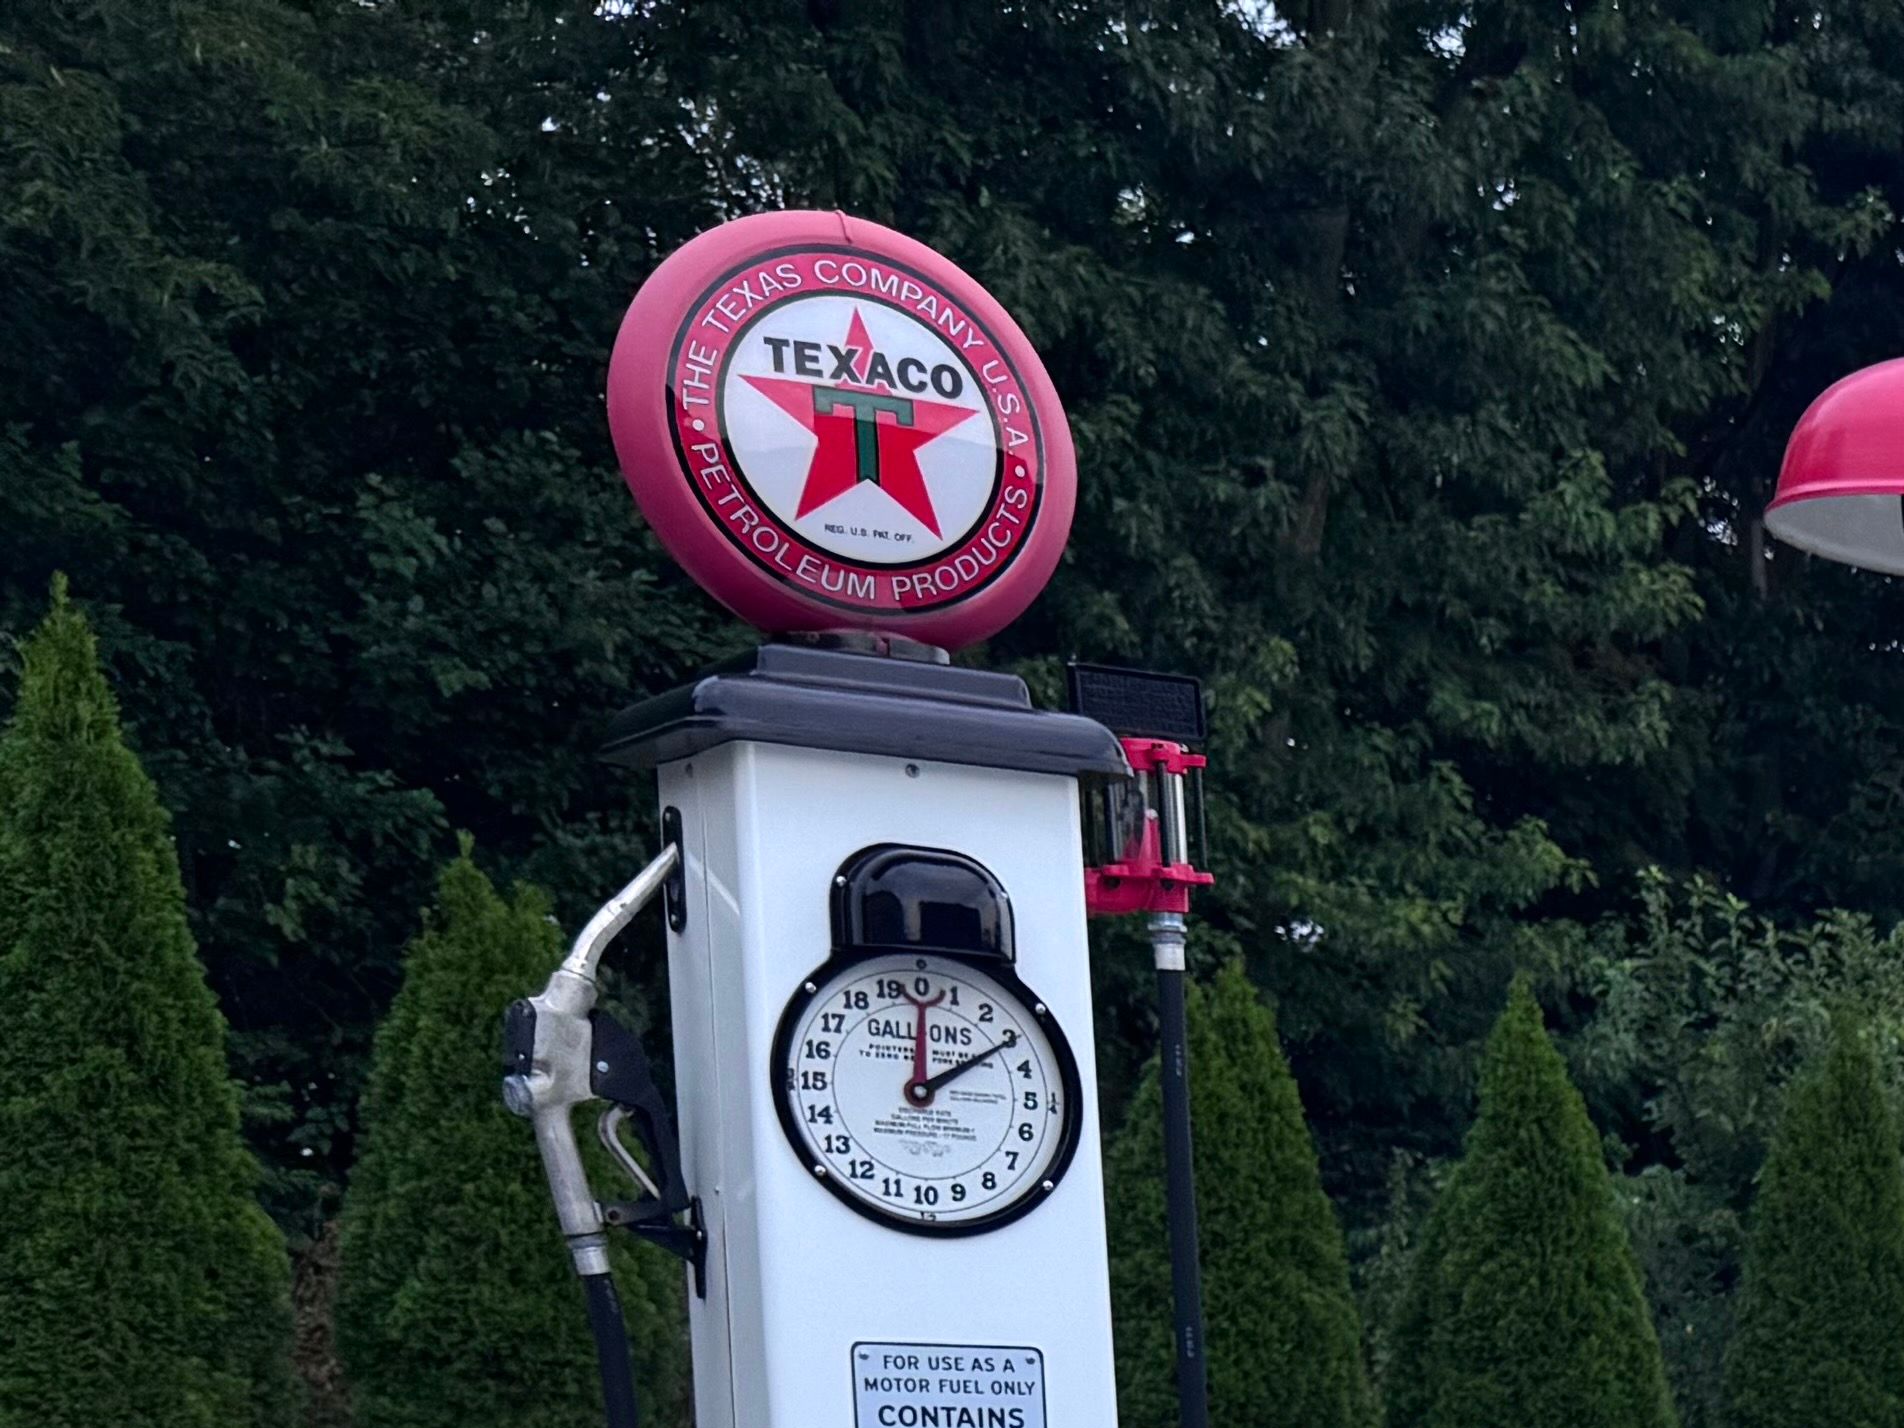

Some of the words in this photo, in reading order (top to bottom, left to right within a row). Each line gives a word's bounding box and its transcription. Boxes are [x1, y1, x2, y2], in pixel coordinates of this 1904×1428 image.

[682, 339, 718, 410] THE
[701, 262, 803, 334] TEXAS
[813, 259, 984, 351] COMPANY
[981, 359, 1030, 457] U.S.A.
[762, 336, 964, 400] TEXACO
[690, 441, 876, 600] PETROLEUM
[890, 483, 1028, 600] PRODUCTS
[876, 978, 902, 999] 19
[914, 976, 929, 997] 0
[950, 986, 960, 1007] 1
[843, 990, 869, 1010] 18
[821, 1012, 846, 1034] 17
[978, 1002, 994, 1023] 2
[867, 1018, 972, 1046] GALLONS
[1002, 1029, 1017, 1049] 3
[805, 1039, 831, 1060] 16
[1017, 1059, 1032, 1080] 4
[801, 1070, 827, 1091] 15
[1023, 1091, 1039, 1111] 5
[808, 1104, 833, 1125] 14
[1018, 1122, 1034, 1142] 6
[824, 1134, 851, 1155] 13
[848, 1159, 875, 1180] 12
[1005, 1151, 1019, 1171] 7
[882, 1177, 904, 1198] 11
[981, 1171, 997, 1190] 8
[913, 1185, 939, 1206] 10
[950, 1183, 966, 1202] 9
[883, 1354, 919, 1371] FOR
[928, 1356, 965, 1371] USE
[971, 1357, 996, 1372] AS
[1002, 1358, 1016, 1373] A
[863, 1377, 930, 1393] MOTOR
[938, 1379, 985, 1395] FUEL
[990, 1380, 1036, 1396] ONLY
